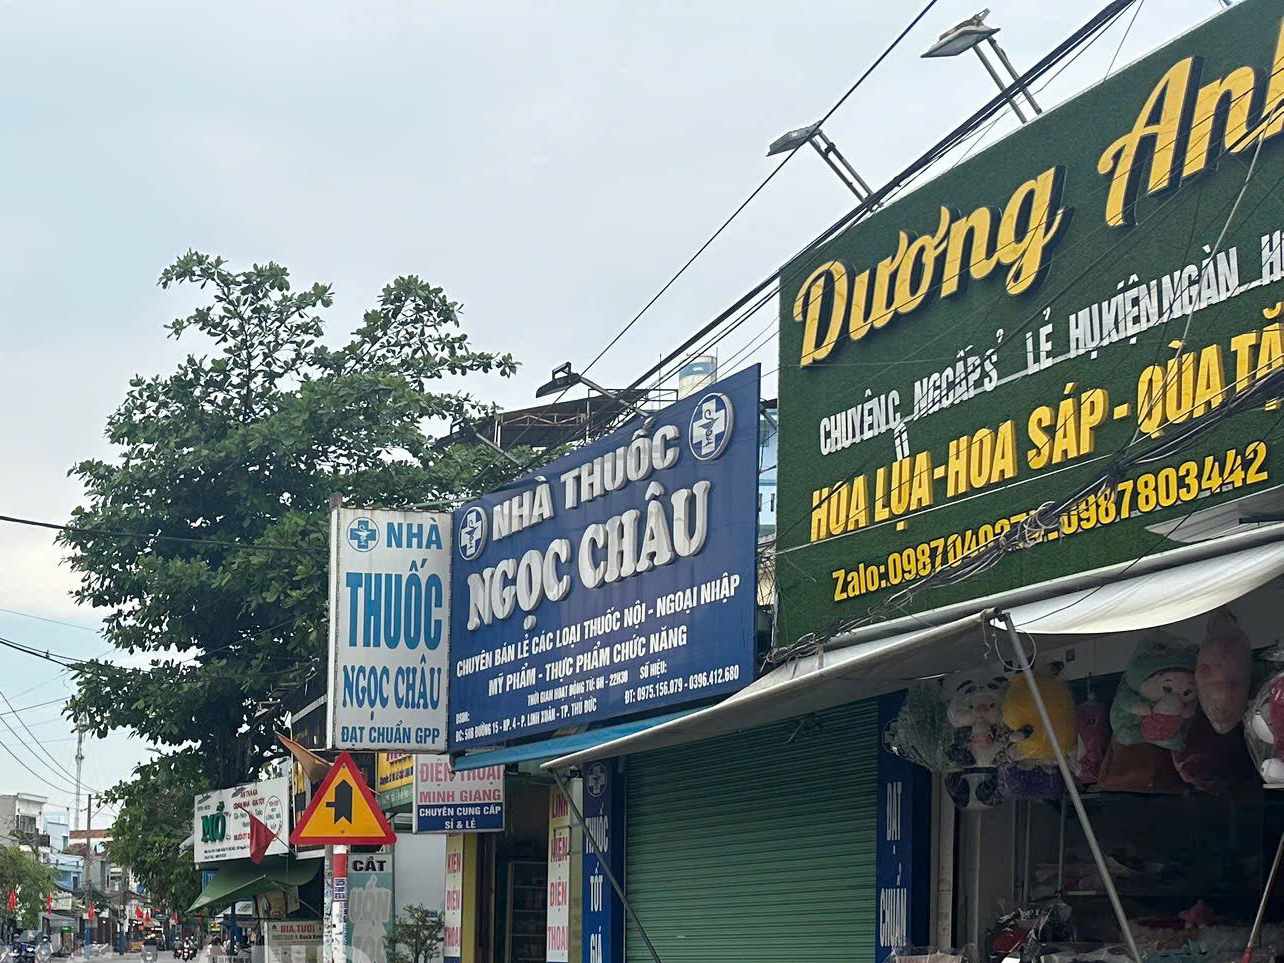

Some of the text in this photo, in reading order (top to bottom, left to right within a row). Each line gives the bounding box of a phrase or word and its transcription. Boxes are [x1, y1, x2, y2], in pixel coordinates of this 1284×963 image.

[793, 165, 1069, 367] Dương
[492, 416, 680, 541] NHÀ THUỐC
[810, 474, 869, 544] HOA
[1027, 382, 1109, 470] SÁP
[387, 517, 443, 550] NHÀ
[467, 480, 711, 630] NGỌC CHÂU
[346, 558, 443, 650] THUỐC
[456, 572, 741, 677] CHUYÊN BÁN LẺ CÁC LOẠI THUỐC NỘI NGOẠI NHẬP
[342, 653, 442, 721] NGỌC CHÂU
[505, 663, 536, 692] PHẨM
[545, 652, 574, 682] THỰC
[575, 641, 611, 673] PHẨM
[613, 634, 647, 663] CHỨC
[649, 624, 688, 651] NĂNG
[341, 720, 440, 746] ĐẠT CHUẨN GPP
[419, 788, 501, 803] MINH GIANG
[419, 803, 502, 817] CHUYÊN CUNG CẤP
[352, 855, 387, 872] CẮT
